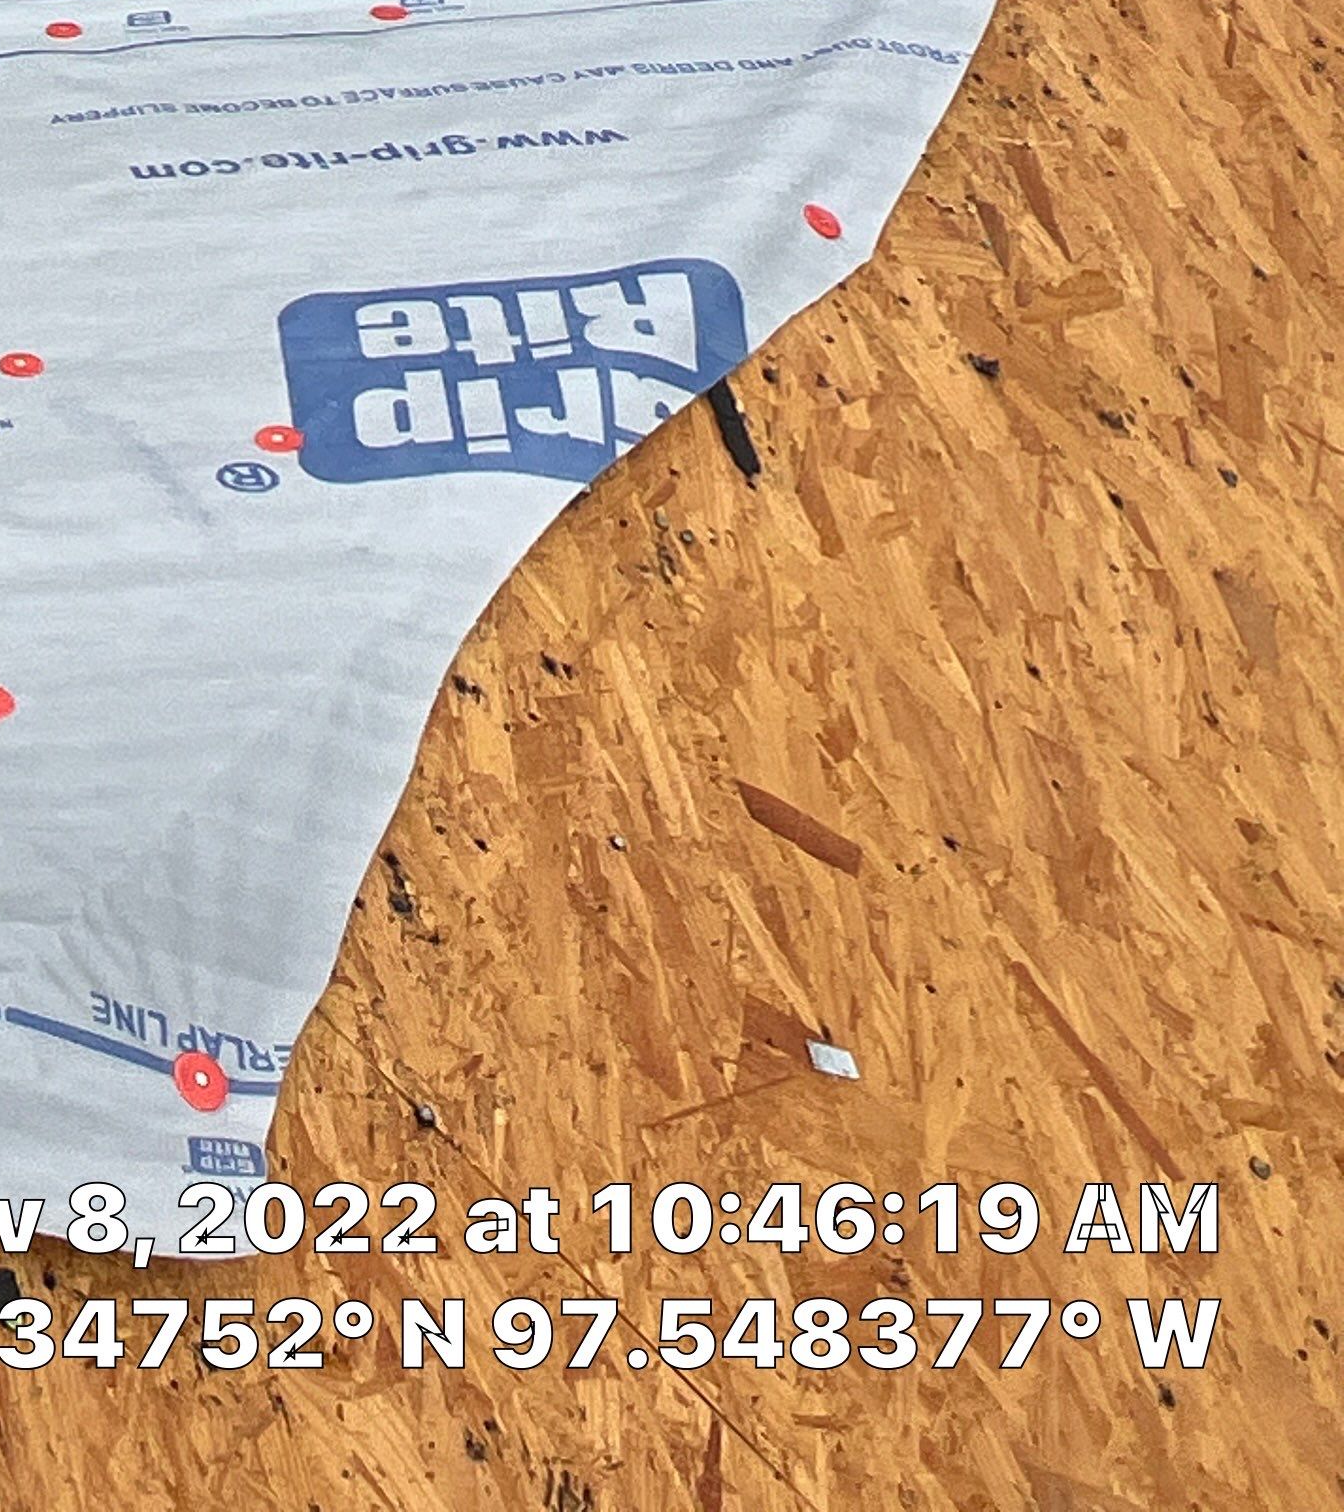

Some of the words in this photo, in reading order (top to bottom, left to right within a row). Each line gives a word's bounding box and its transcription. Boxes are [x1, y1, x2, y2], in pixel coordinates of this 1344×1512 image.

[630, 58, 736, 75] DEBRIS
[738, 56, 794, 72] AND
[473, 71, 567, 91] CAUSE
[300, 94, 337, 108] TO
[339, 81, 469, 105] SURFACE
[49, 102, 178, 126] SLIPPERY
[184, 96, 299, 115] BECOME
[128, 128, 629, 182] www.grip-rite.com
[355, 271, 700, 373] Rite
[90, 990, 169, 1047] LINE
[177, 1023, 296, 1073] ERLAP
